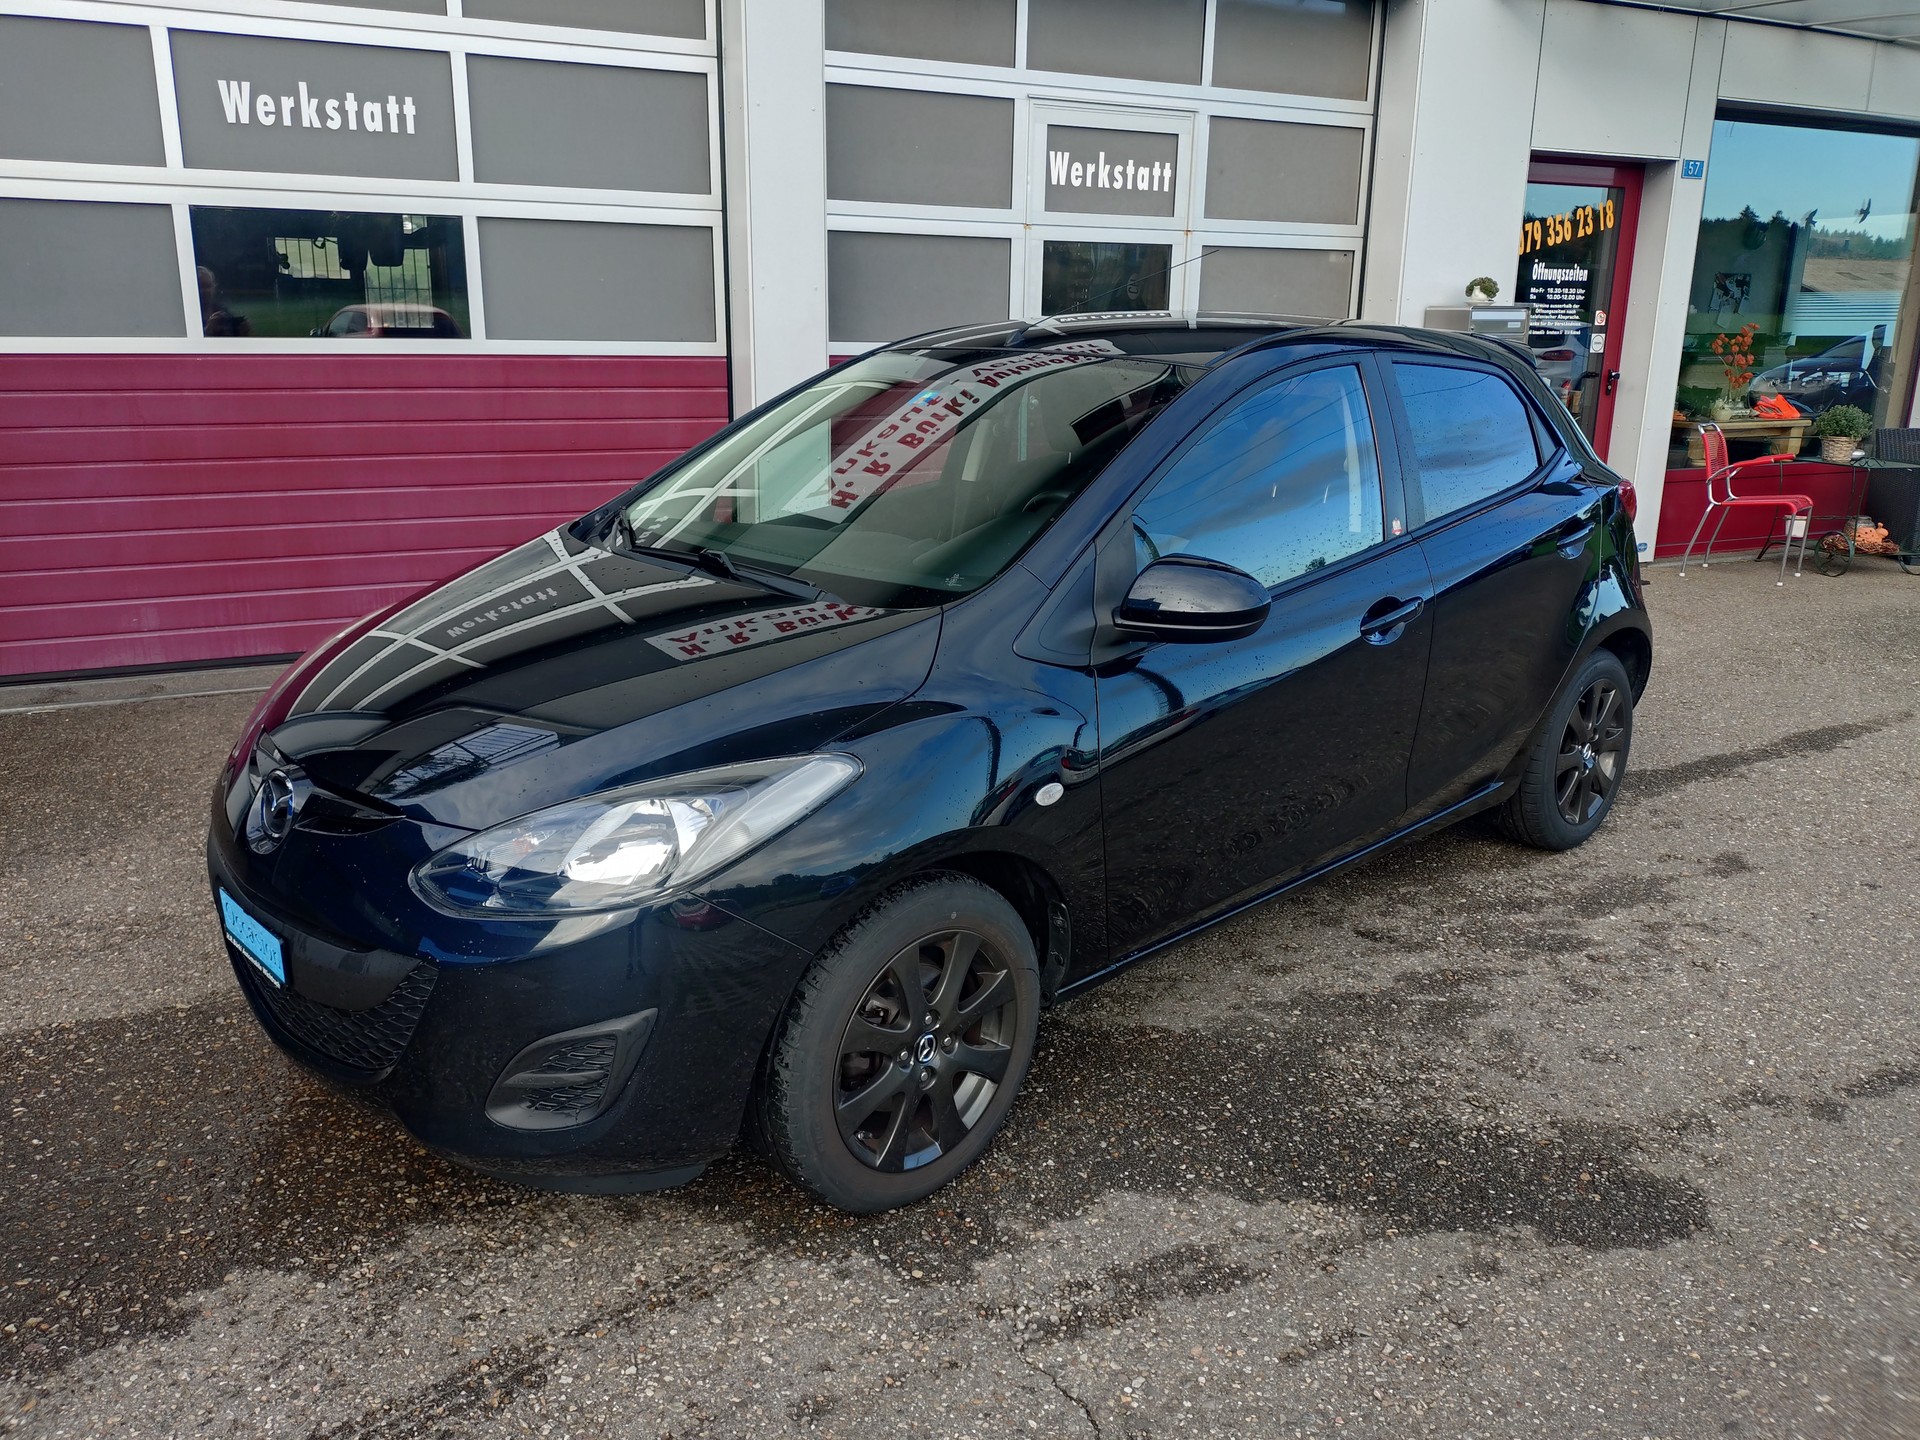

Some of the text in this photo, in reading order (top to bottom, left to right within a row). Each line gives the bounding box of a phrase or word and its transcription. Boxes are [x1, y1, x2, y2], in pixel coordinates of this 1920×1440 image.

[217, 80, 416, 134] Werkstatt
[1049, 151, 1172, 192] Werkstatt
[1688, 161, 1701, 175] 57
[1546, 211, 1572, 247] 356
[1576, 206, 1594, 238] 23
[1598, 199, 1615, 231] 18
[1532, 259, 1588, 284] Öffnungszeiten
